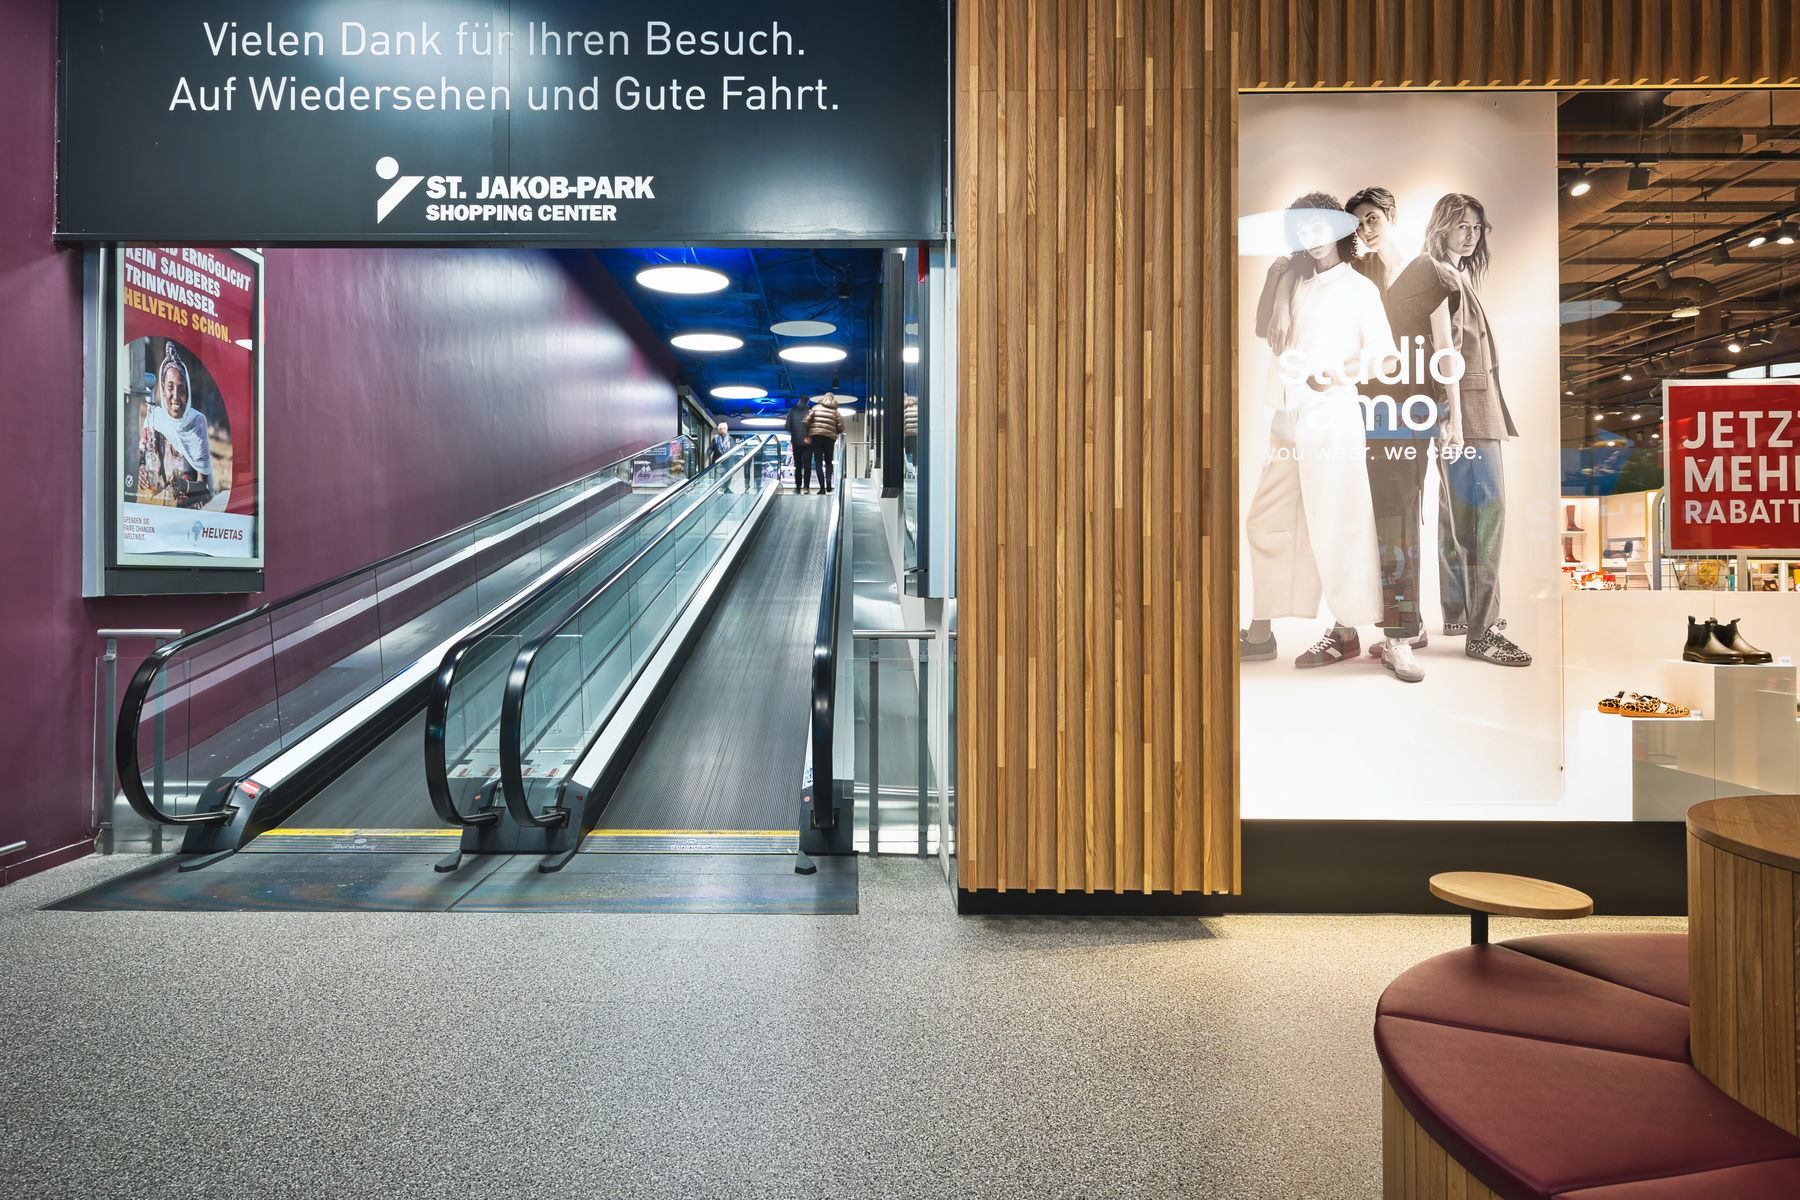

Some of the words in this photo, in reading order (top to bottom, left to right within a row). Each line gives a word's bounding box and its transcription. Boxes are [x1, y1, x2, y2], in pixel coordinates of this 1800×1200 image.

[203, 21, 324, 56] Vielen
[342, 21, 442, 56] Dank
[456, 21, 514, 56] für
[529, 21, 629, 56] Ihren
[646, 20, 805, 56] Besuch.
[168, 76, 237, 112] Auf
[247, 75, 510, 111] Wiedersehen
[528, 75, 599, 111] und
[615, 75, 706, 111] Gute
[722, 75, 839, 111] Fahrt.
[426, 175, 467, 199] ST.
[476, 175, 656, 199] JAKOB-PARK
[425, 204, 533, 222] SHOPPING
[537, 204, 618, 222] CENTER
[125, 248, 157, 270] KEIN
[160, 256, 221, 298] SAUBERES
[182, 248, 251, 292] ERMÖGLICHT
[125, 262, 219, 318] TRINKWASSER.
[124, 286, 188, 327] HELVETAS
[191, 313, 232, 344] SCHON.
[1278, 335, 1466, 385] studio
[1306, 394, 1438, 431] amo
[1683, 411, 1800, 449] JETZ
[1264, 446, 1305, 465] you
[1384, 446, 1417, 460] we
[1427, 446, 1482, 460] care.
[1684, 456, 1800, 492] MEH
[202, 527, 243, 540] HELVETAS
